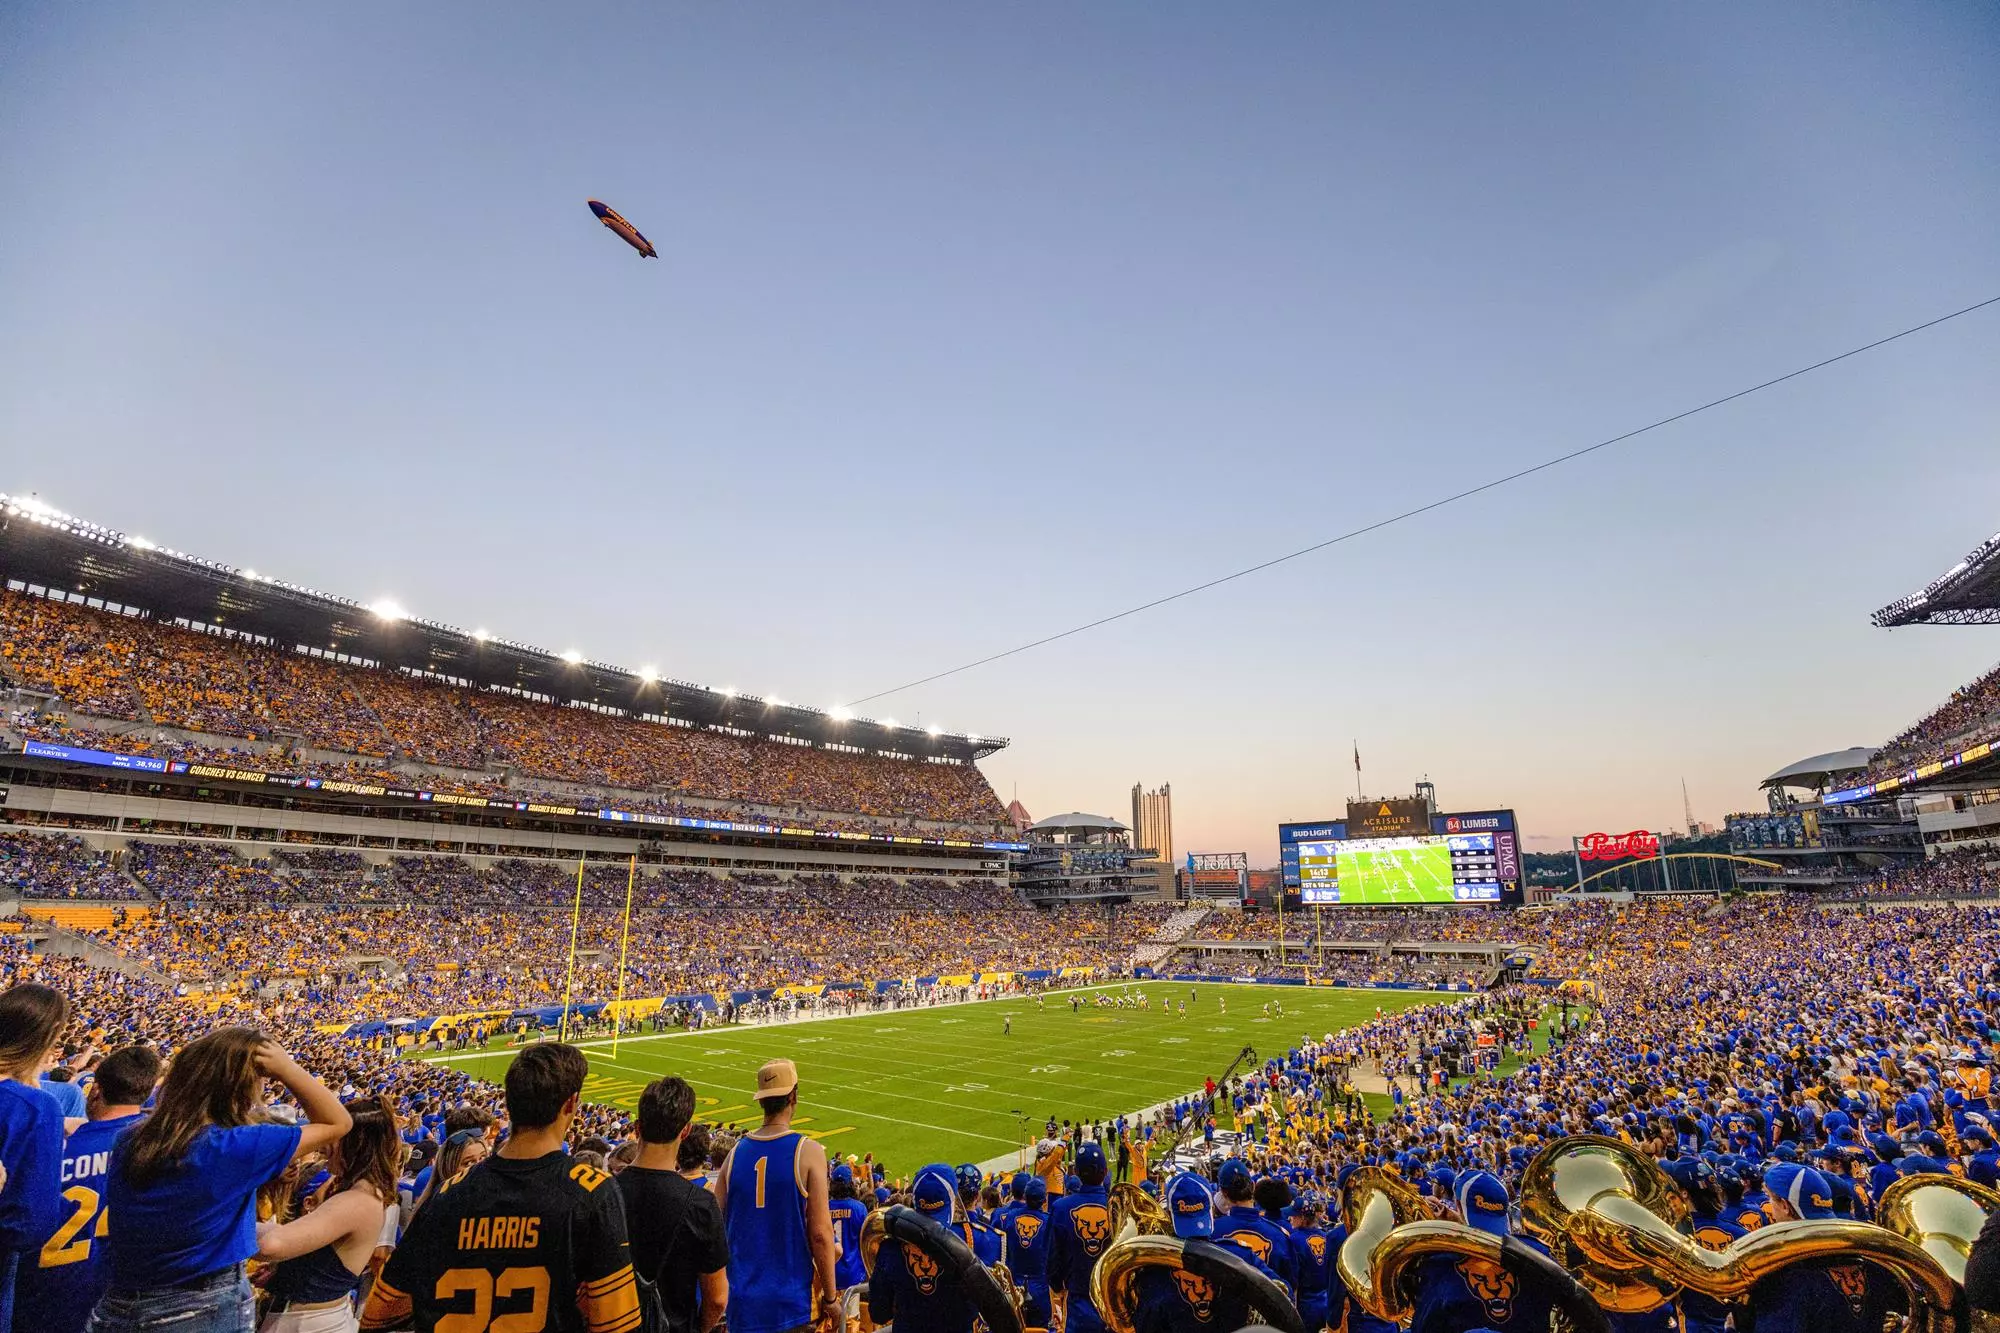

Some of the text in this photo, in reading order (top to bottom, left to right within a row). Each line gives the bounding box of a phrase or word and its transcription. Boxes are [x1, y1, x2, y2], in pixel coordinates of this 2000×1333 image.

[29, 747, 69, 758] CLEARVIEW
[189, 765, 226, 778] COACHES
[226, 769, 236, 780] VS
[235, 772, 266, 784] CANCER
[321, 780, 351, 792] COACHES
[359, 786, 386, 796] CANCER
[432, 793, 488, 808] COACHES VS CANCER
[528, 803, 551, 813] COACHES
[556, 807, 576, 816] CANCER
[1362, 816, 1412, 827] ACRISURE
[1447, 818, 1499, 830] 84 LUMBER
[1292, 829, 1333, 838] BUD LIGHT
[1500, 835, 1516, 876] UPMC
[61, 1150, 114, 1183] CON
[754, 1155, 768, 1209] 1
[38, 1185, 110, 1269] 2
[457, 1215, 542, 1250] HARRIS
